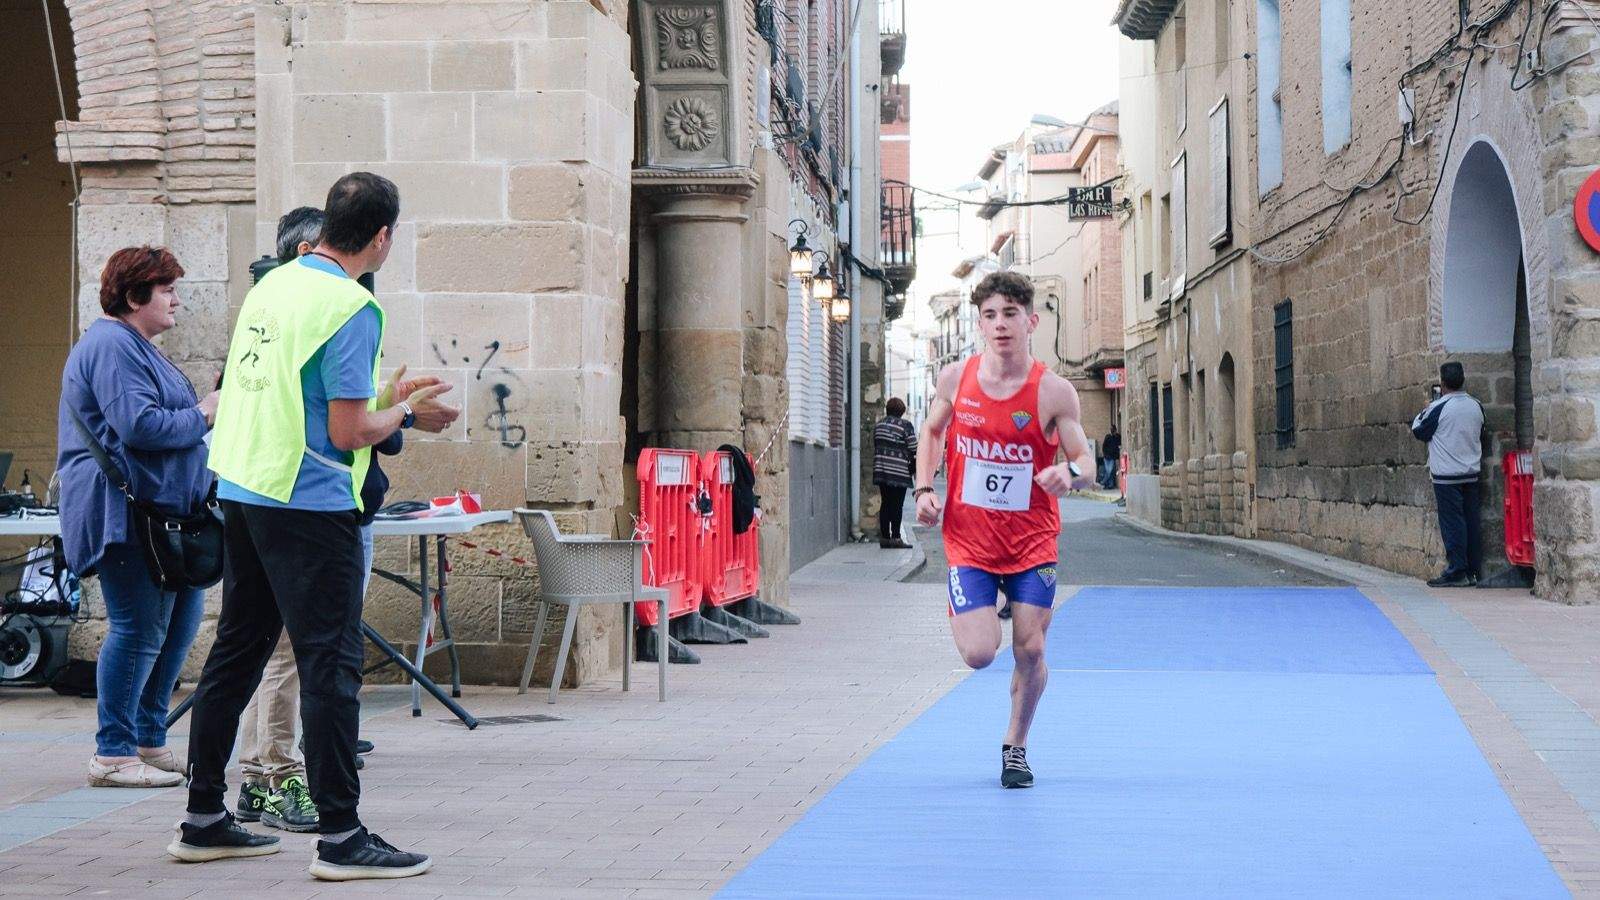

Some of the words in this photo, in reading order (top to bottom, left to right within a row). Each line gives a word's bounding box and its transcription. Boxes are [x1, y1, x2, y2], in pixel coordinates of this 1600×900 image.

[1076, 187, 1105, 201] BAR
[1070, 203, 1086, 217] LAS
[985, 474, 1013, 493] 67
